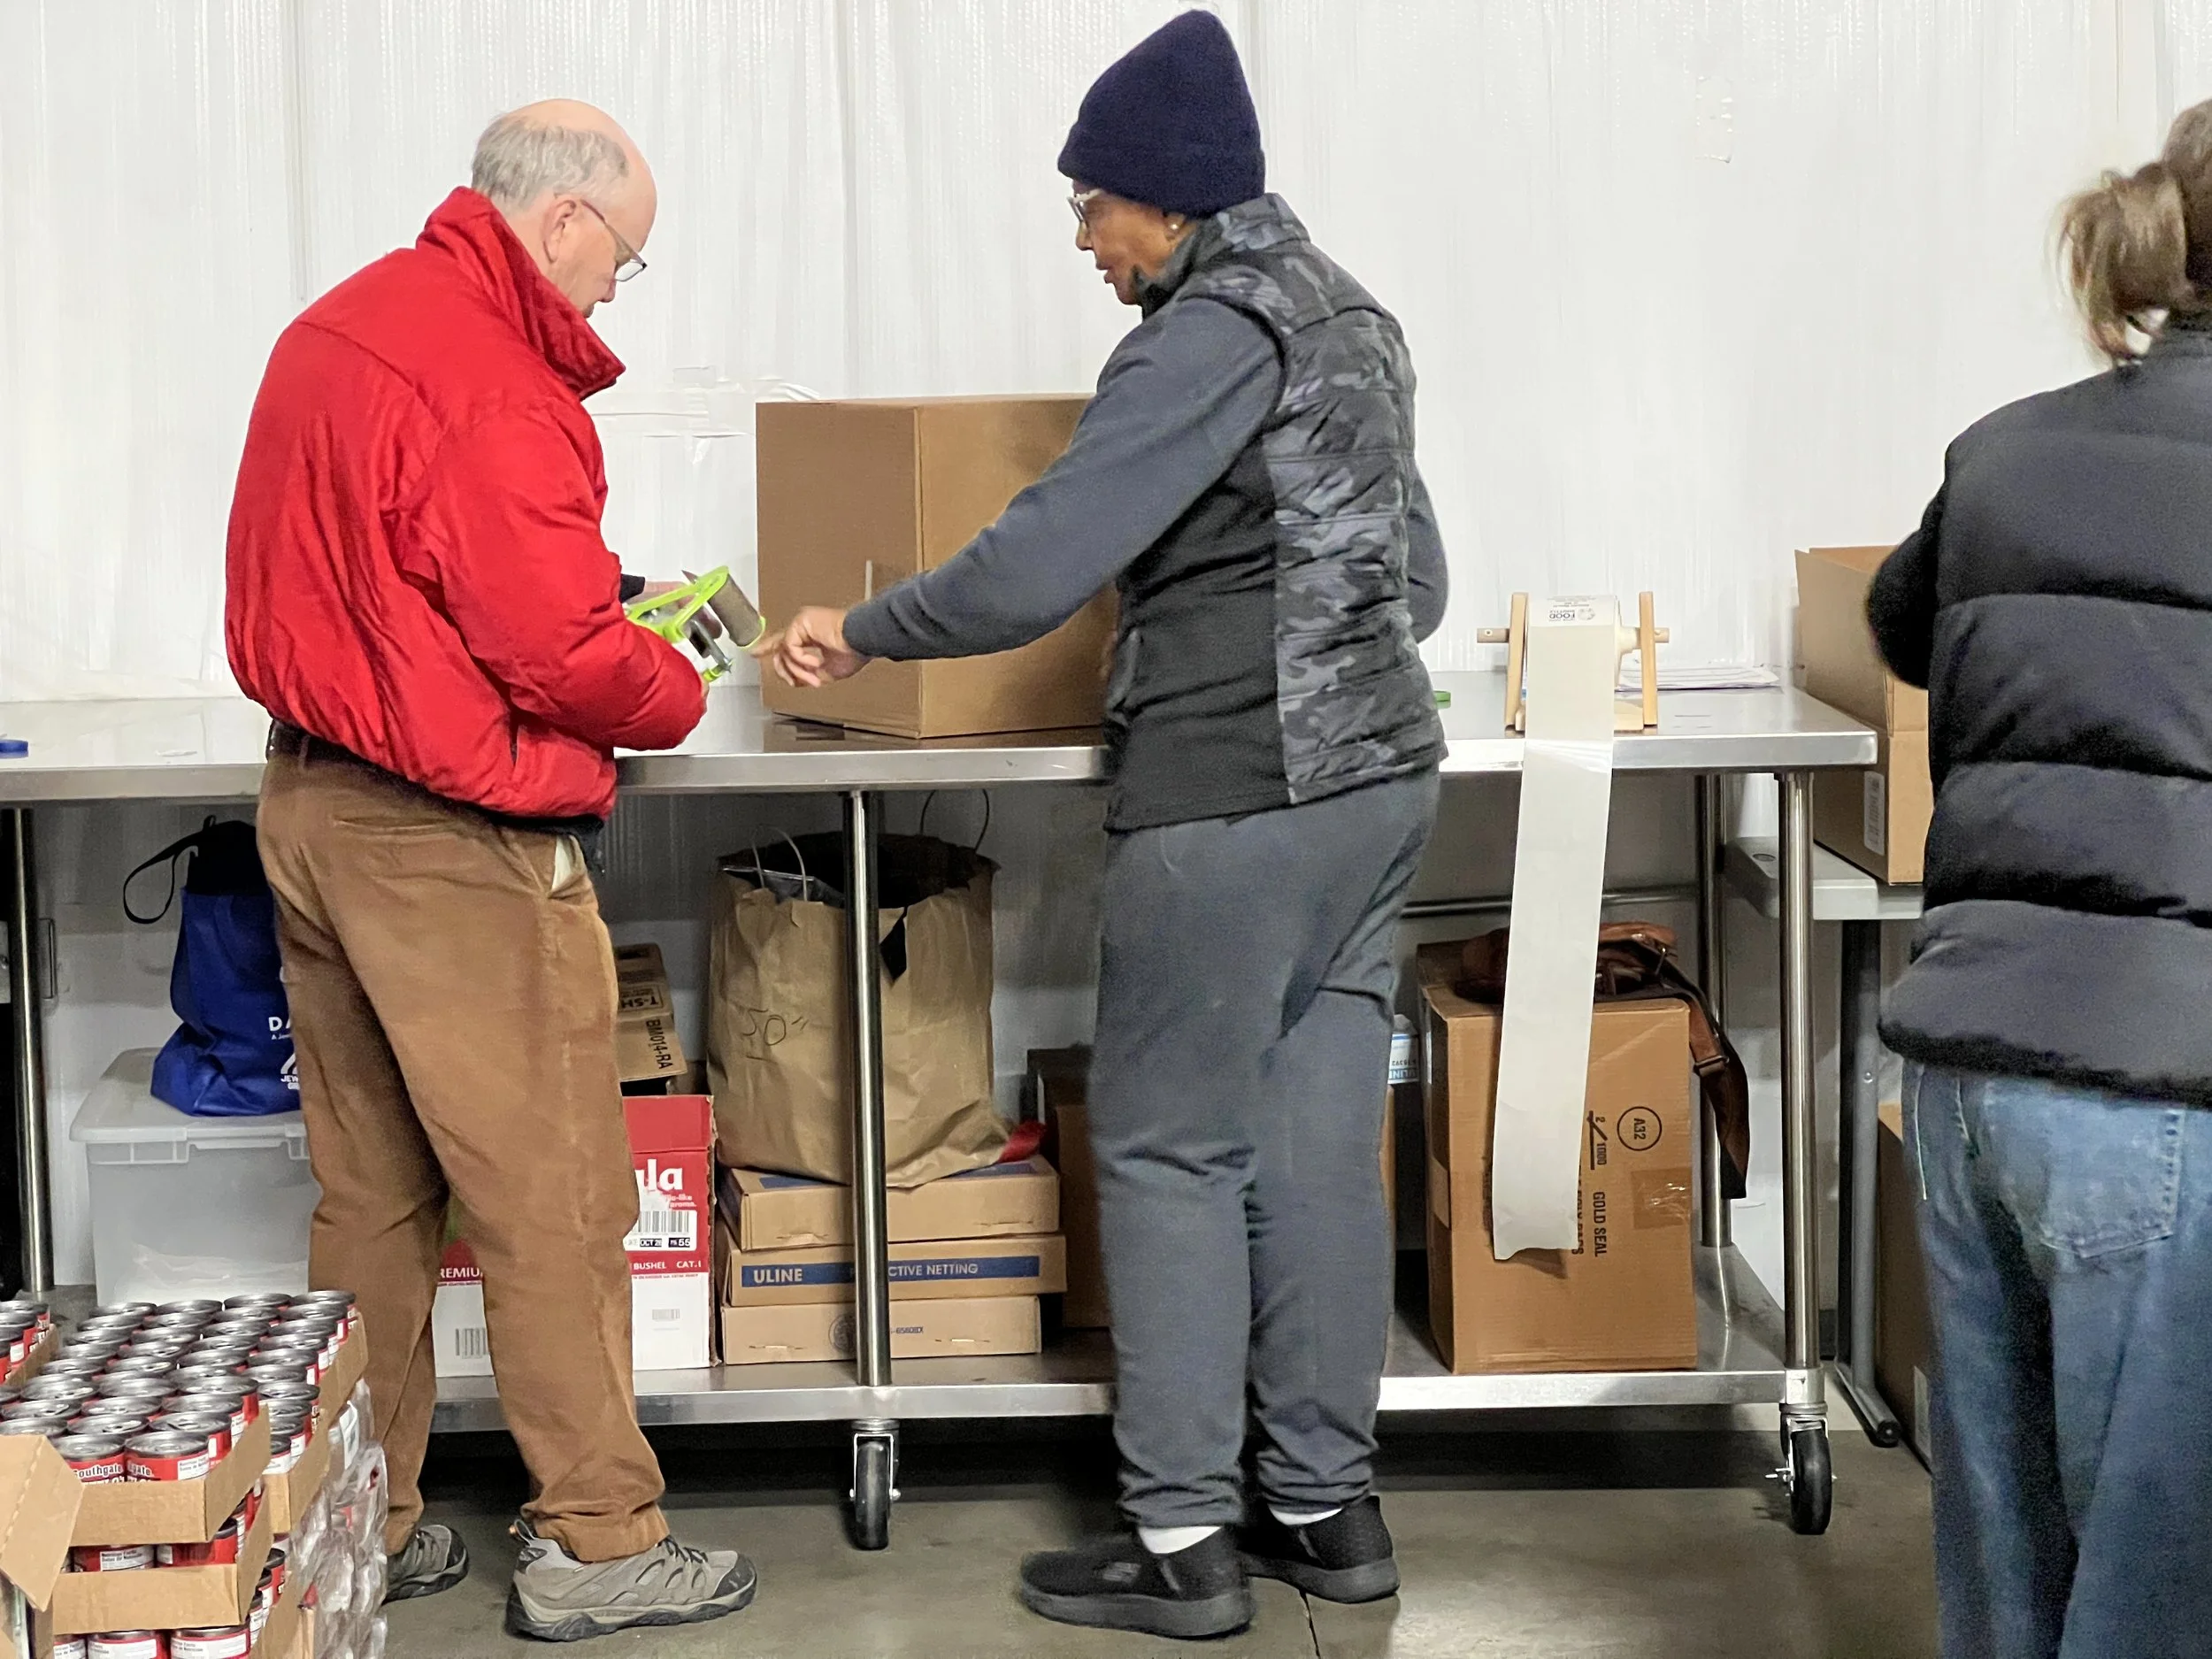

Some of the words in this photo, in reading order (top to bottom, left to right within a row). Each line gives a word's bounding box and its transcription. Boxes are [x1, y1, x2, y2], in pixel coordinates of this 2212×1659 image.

[1633, 1118, 1647, 1141] A32
[1593, 1192, 1606, 1224] GOLD
[1594, 1227, 1607, 1257] SEAL
[440, 1267, 483, 1279] REMIU
[754, 1268, 803, 1283] ULINE
[887, 1264, 922, 1277] CTIVE
[926, 1263, 978, 1275] NETTING
